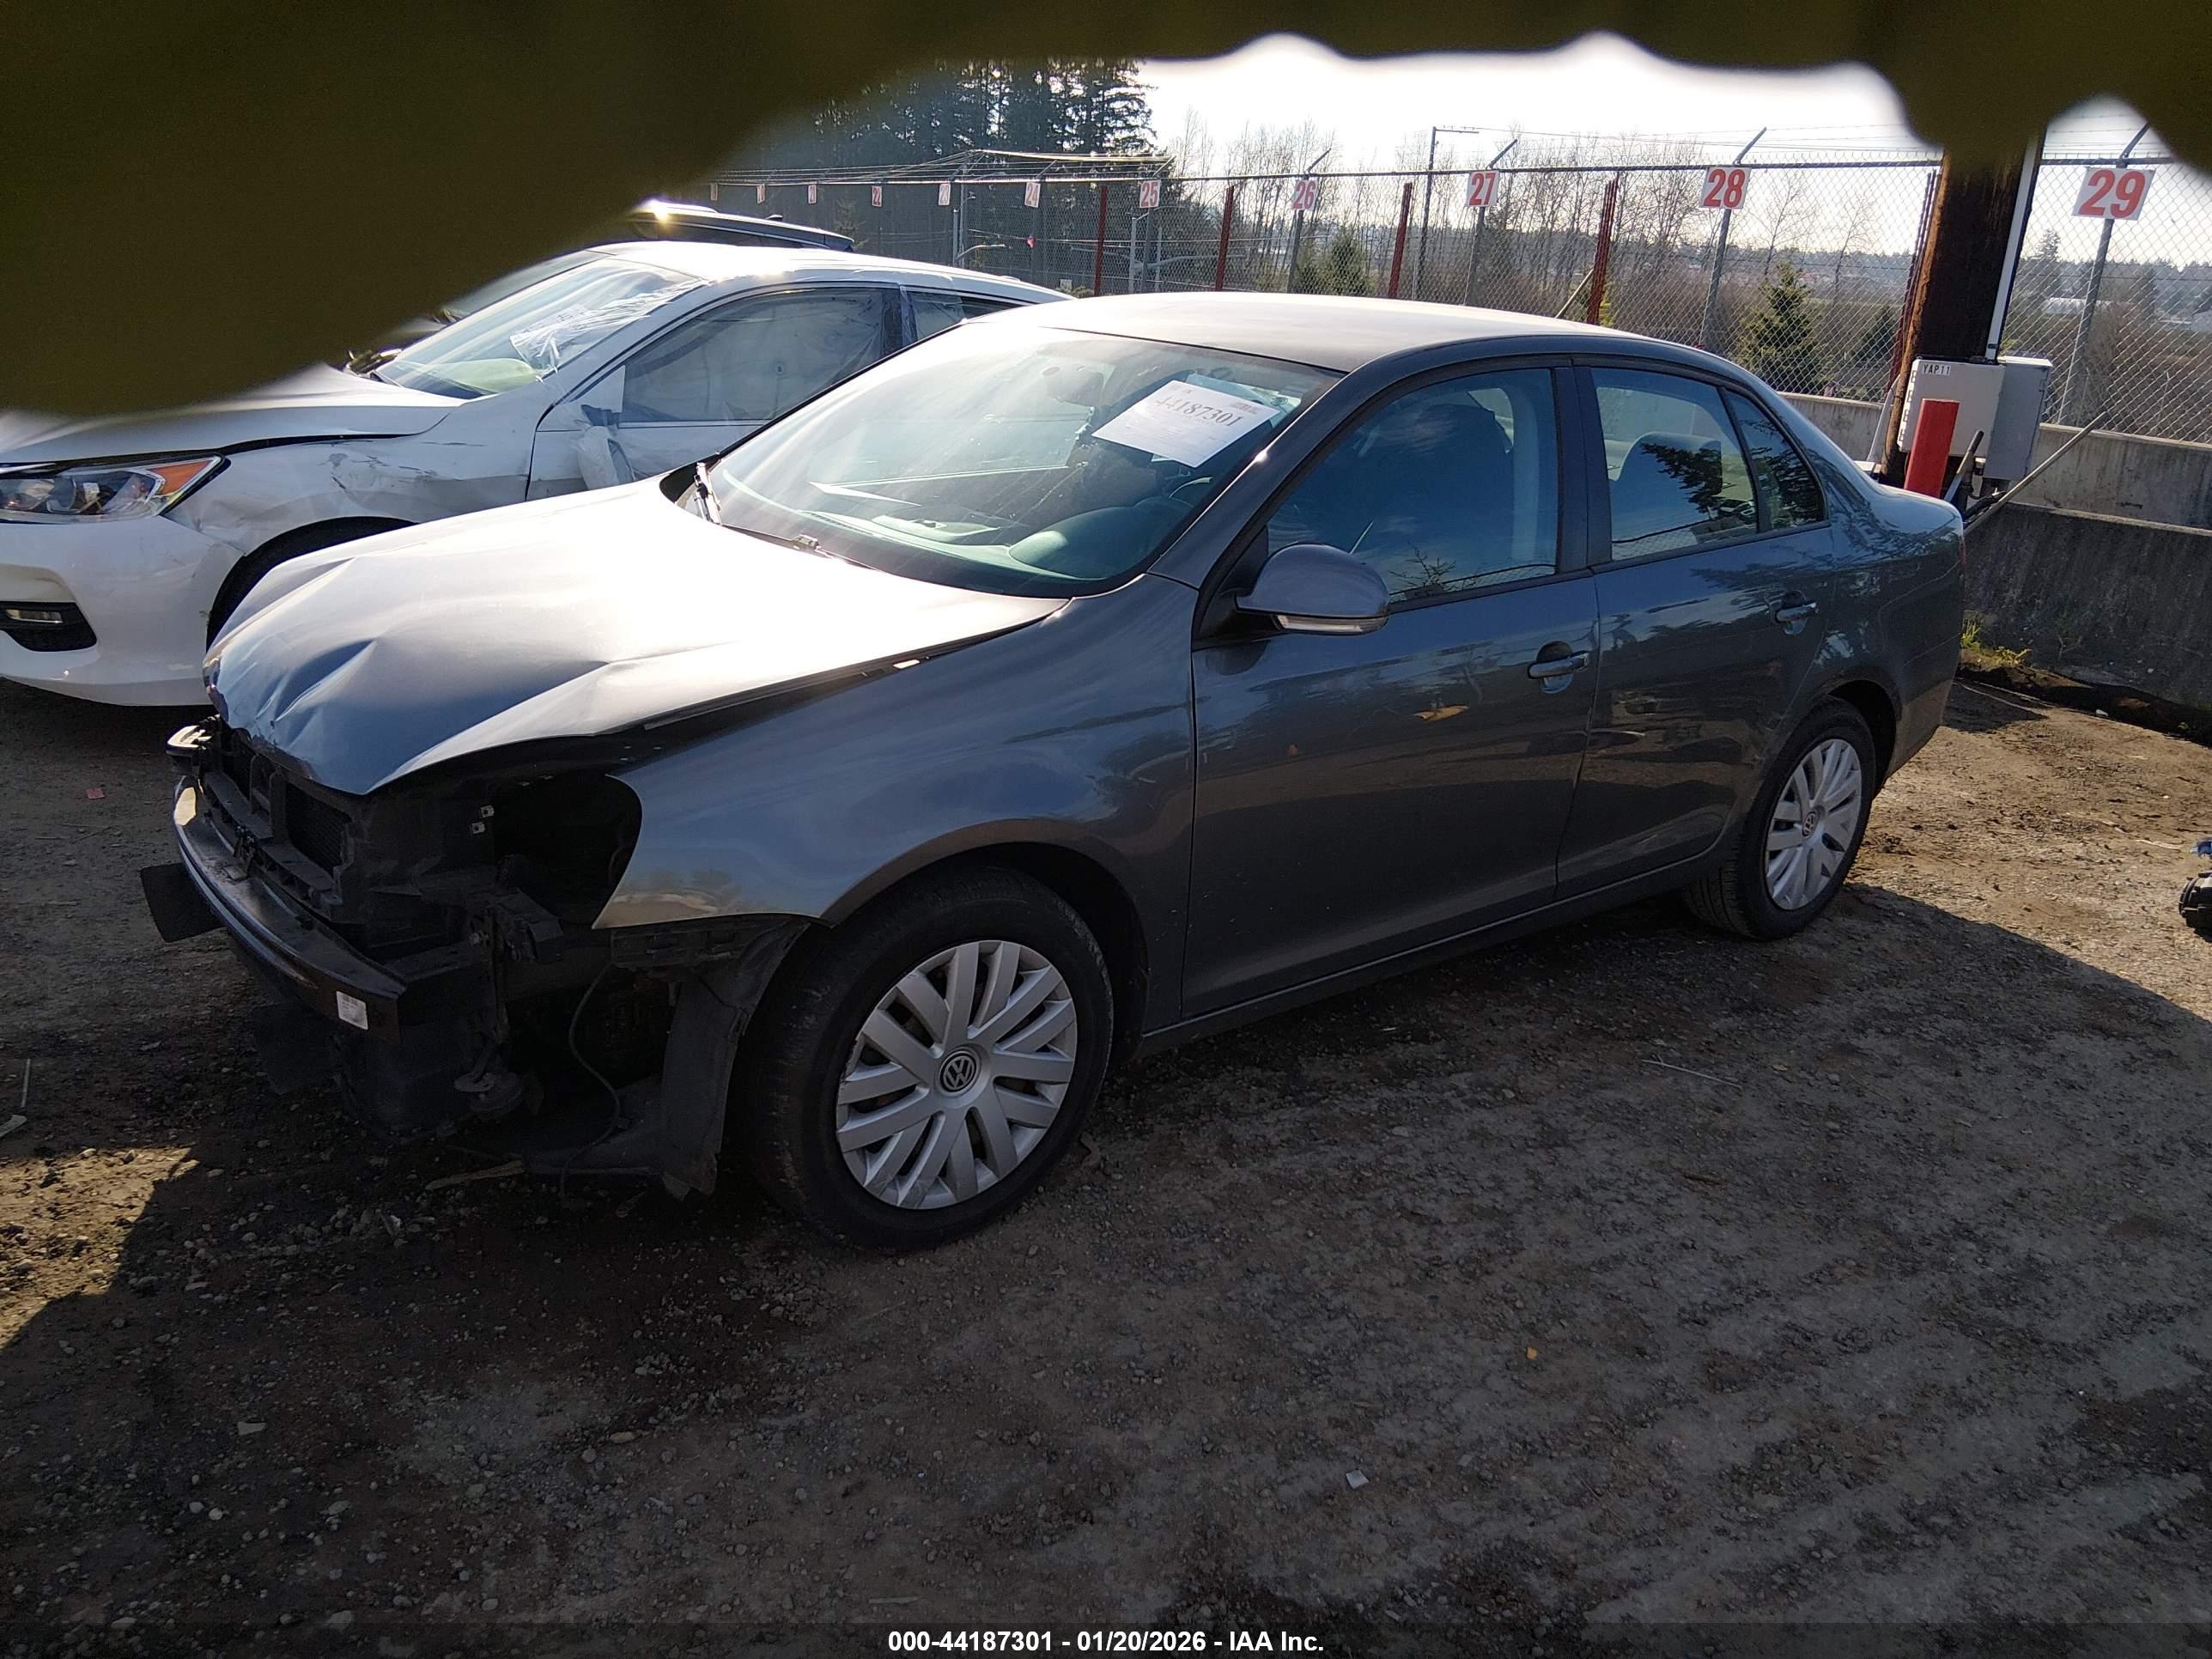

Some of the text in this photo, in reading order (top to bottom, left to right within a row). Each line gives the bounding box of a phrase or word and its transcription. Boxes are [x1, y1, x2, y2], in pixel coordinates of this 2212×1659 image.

[1026, 184, 1039, 206] 24
[1141, 182, 1158, 207] 25
[1293, 181, 1316, 210] 26
[1469, 173, 1496, 205] 27
[1704, 168, 1745, 207] 28
[2078, 169, 2145, 218] 29
[1156, 396, 1244, 427] 44187301
